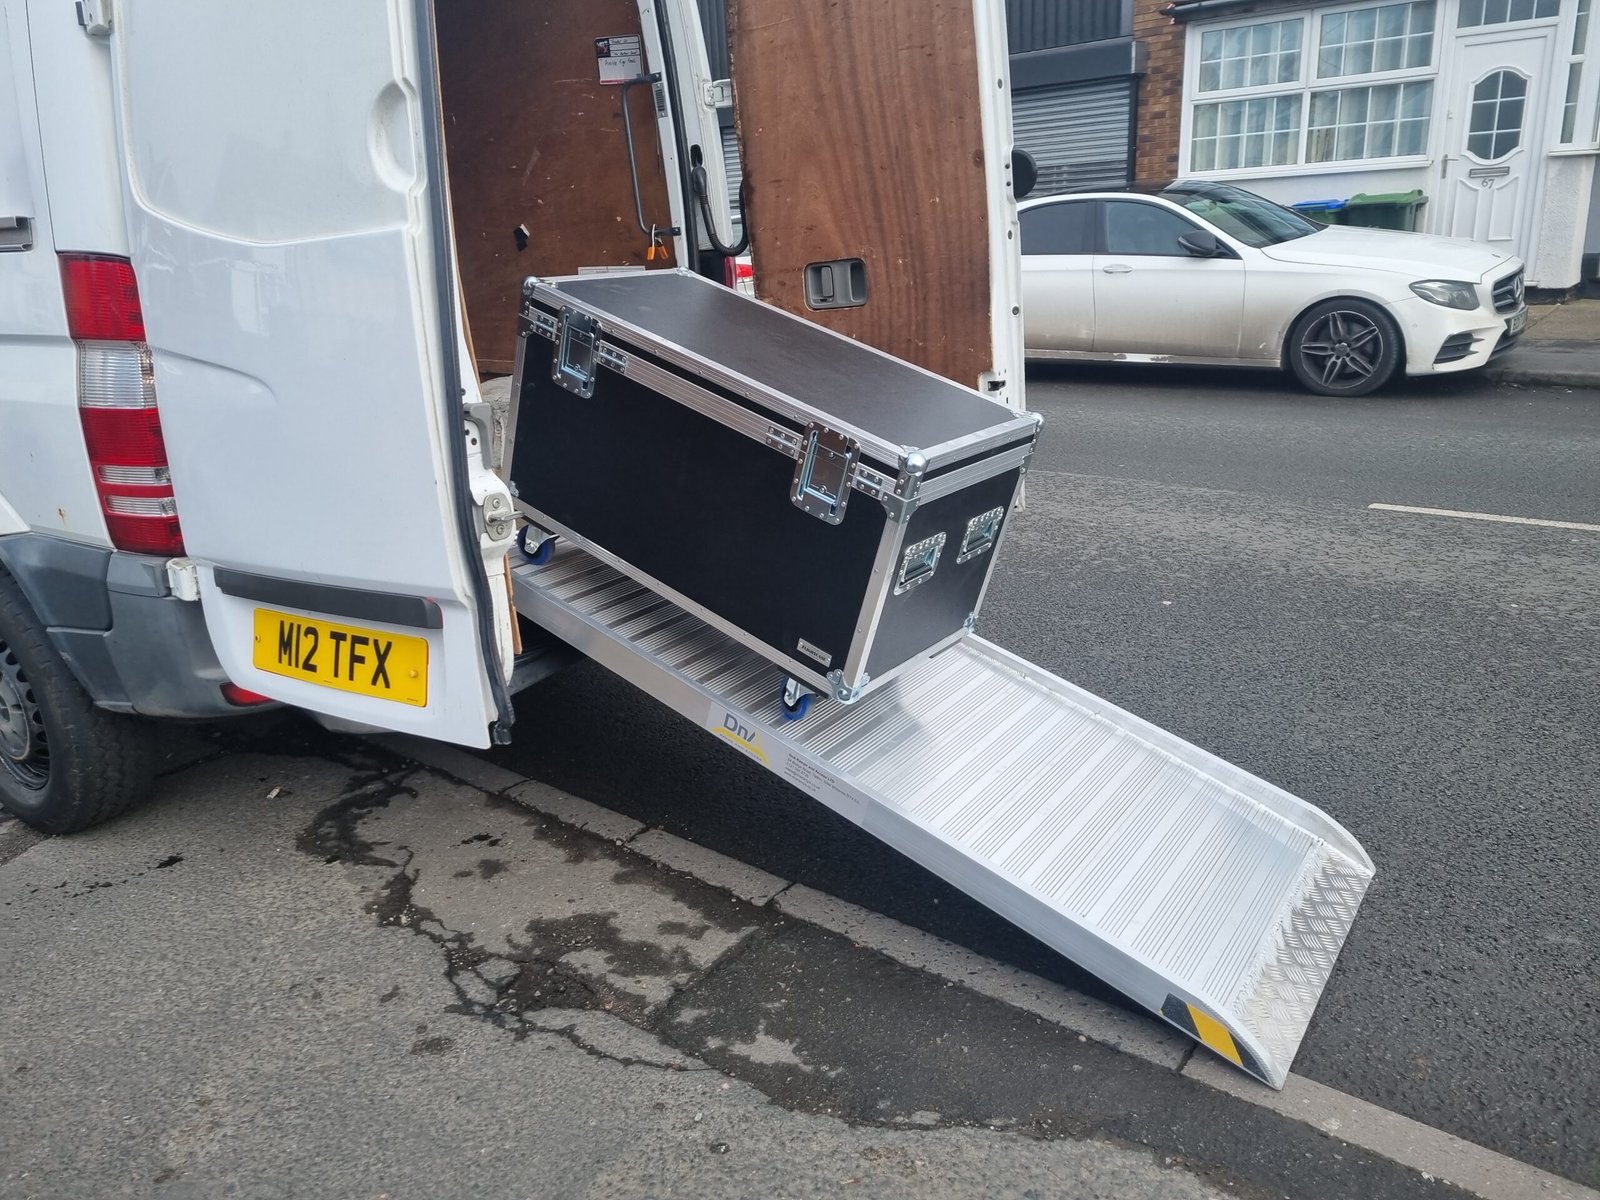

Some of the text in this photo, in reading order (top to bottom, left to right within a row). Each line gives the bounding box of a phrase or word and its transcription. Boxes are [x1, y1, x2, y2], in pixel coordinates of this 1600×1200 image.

[1481, 177, 1495, 190] 67
[278, 620, 393, 689] M12 TFX
